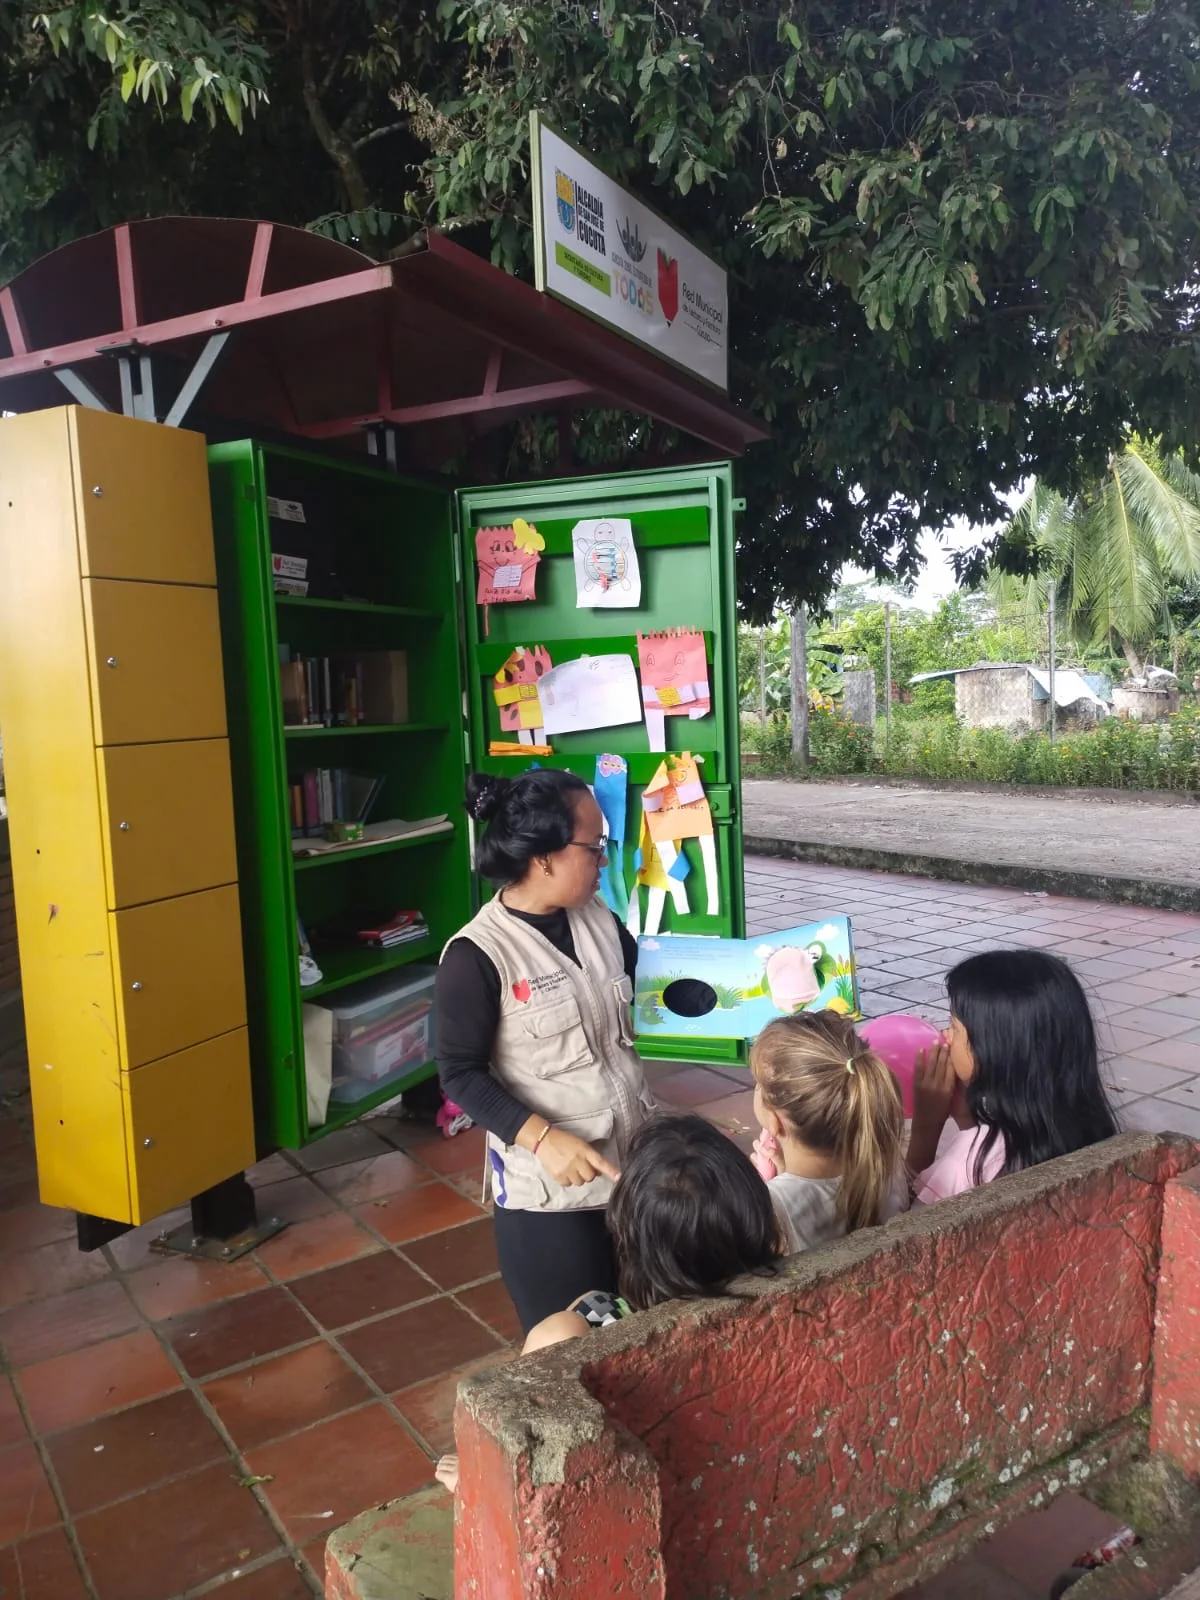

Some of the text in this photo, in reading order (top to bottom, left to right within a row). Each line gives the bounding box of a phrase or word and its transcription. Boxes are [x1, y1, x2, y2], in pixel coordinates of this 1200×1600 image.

[682, 282, 694, 304] Red
[695, 291, 722, 325] Municipal
[539, 969, 565, 981] Municipa
